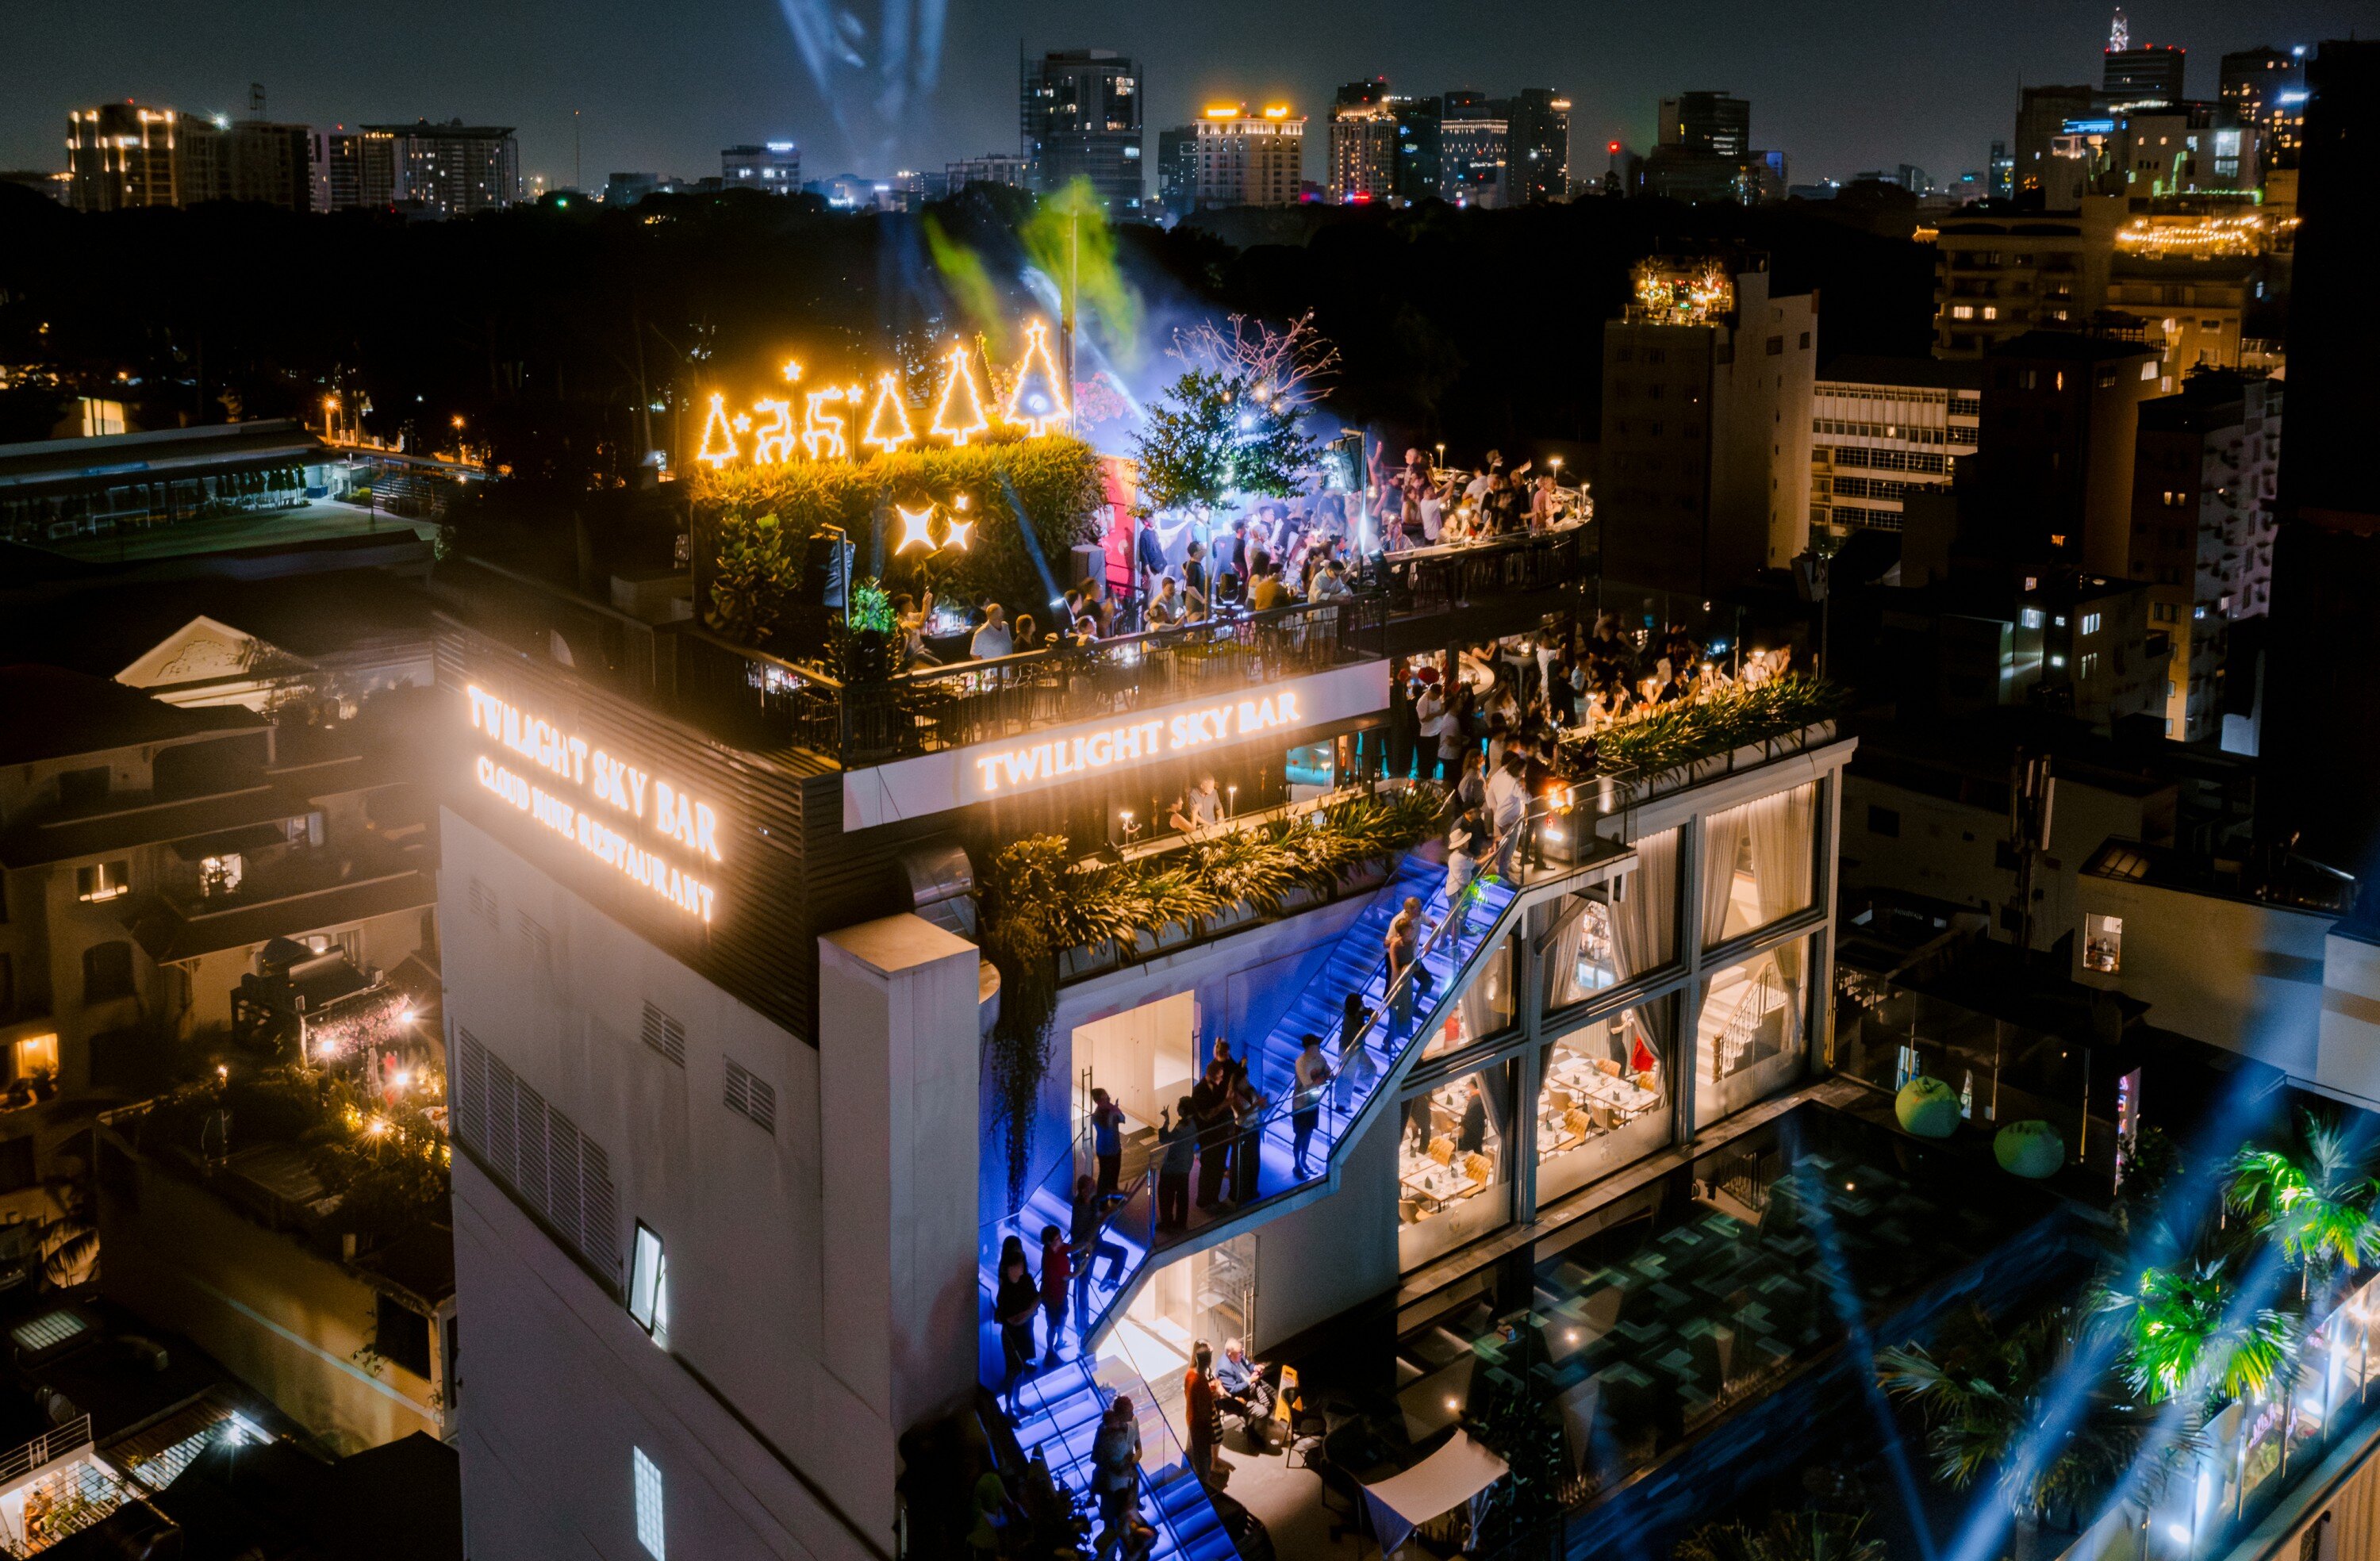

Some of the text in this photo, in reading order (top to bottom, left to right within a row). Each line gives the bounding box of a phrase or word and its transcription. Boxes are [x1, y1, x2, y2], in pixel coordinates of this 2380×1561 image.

[467, 685, 721, 861] TWILIGHT SKY BAR
[977, 692, 1301, 792] TWILIGHT SKY BAR
[477, 755, 530, 811] CLOUD
[577, 812, 715, 922] RESTAURANT
